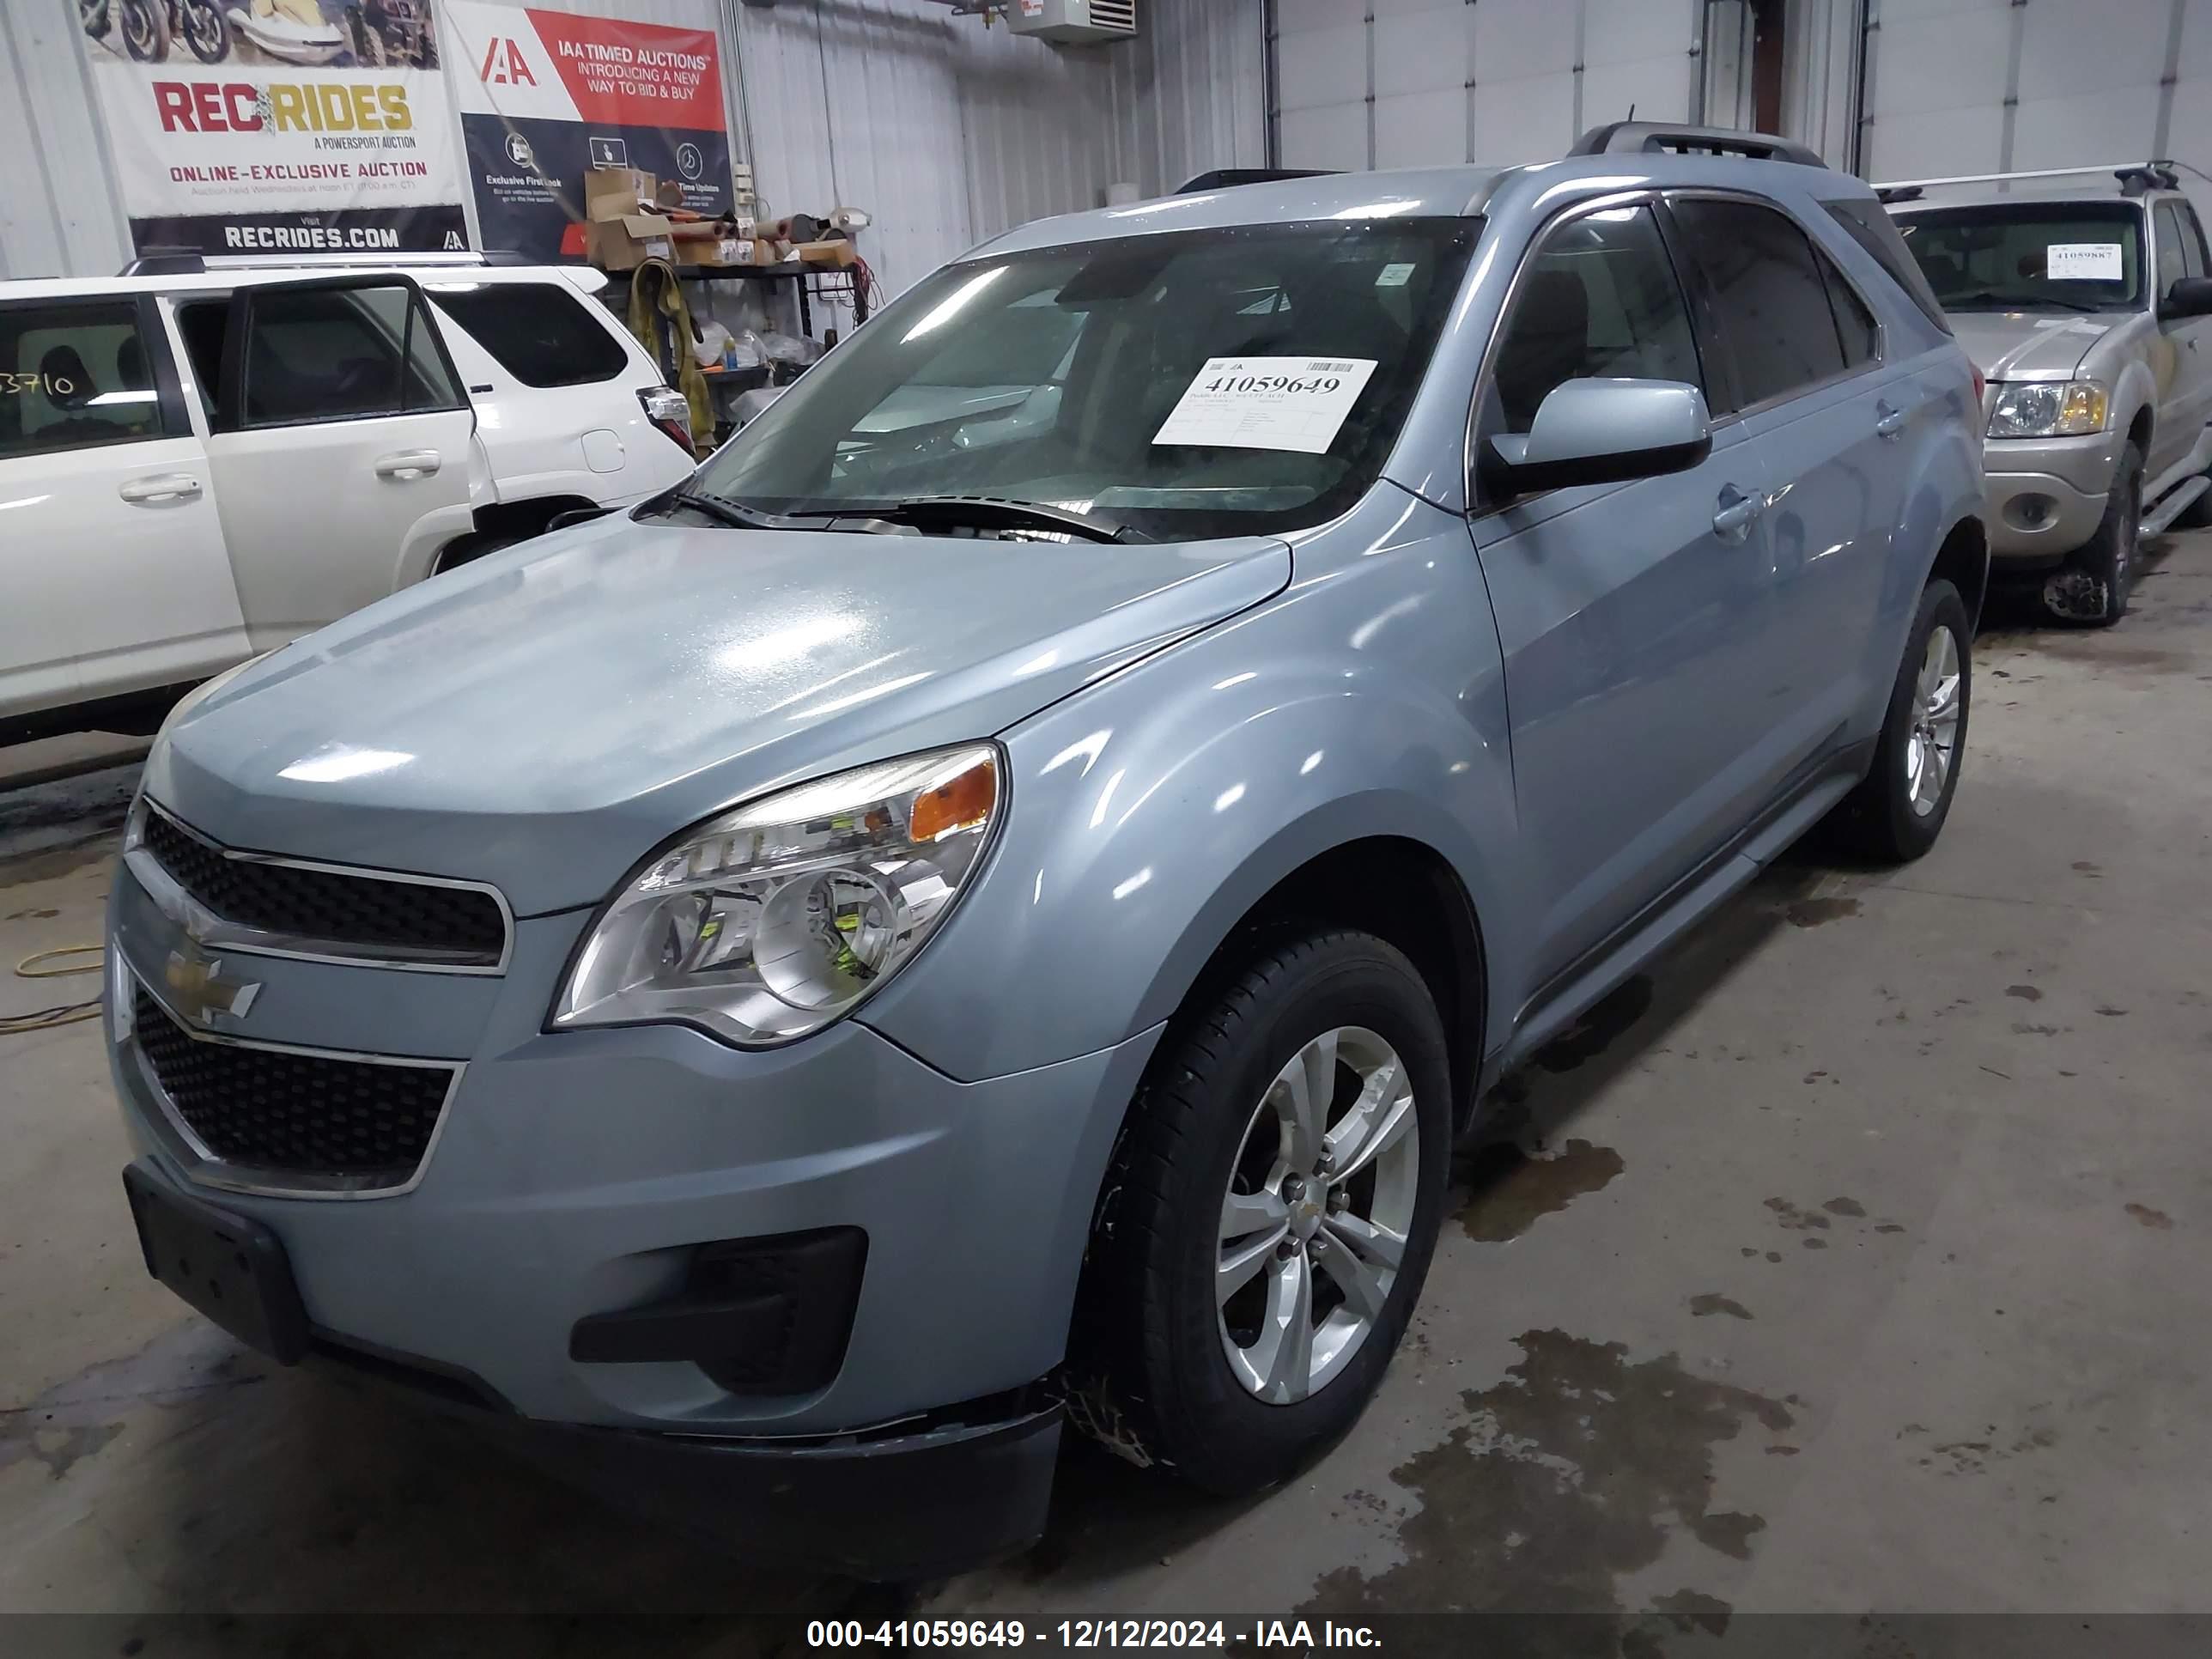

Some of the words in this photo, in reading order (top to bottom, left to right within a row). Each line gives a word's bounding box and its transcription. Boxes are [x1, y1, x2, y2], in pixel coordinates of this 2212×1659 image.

[558, 40, 585, 59] IAA
[585, 43, 634, 64] TIMED
[577, 61, 660, 82] INTRODUCING
[662, 70, 672, 82] A
[673, 71, 701, 86] NEW
[587, 78, 616, 93] WAY
[617, 81, 637, 95] TO
[639, 82, 658, 97] BID
[659, 84, 670, 98] &
[672, 85, 695, 100] BUY
[314, 137, 322, 150] A
[322, 137, 380, 150] POWERSPORT
[381, 136, 416, 149] AUCTION
[170, 164, 351, 182] ONLINE-EXCLUSIVE
[358, 161, 428, 177] AUCTION
[486, 174, 526, 185] Exclusive
[301, 216, 320, 226] Visit
[224, 227, 400, 248] RECRIDES.COM
[1205, 376, 1340, 395] 41059649
